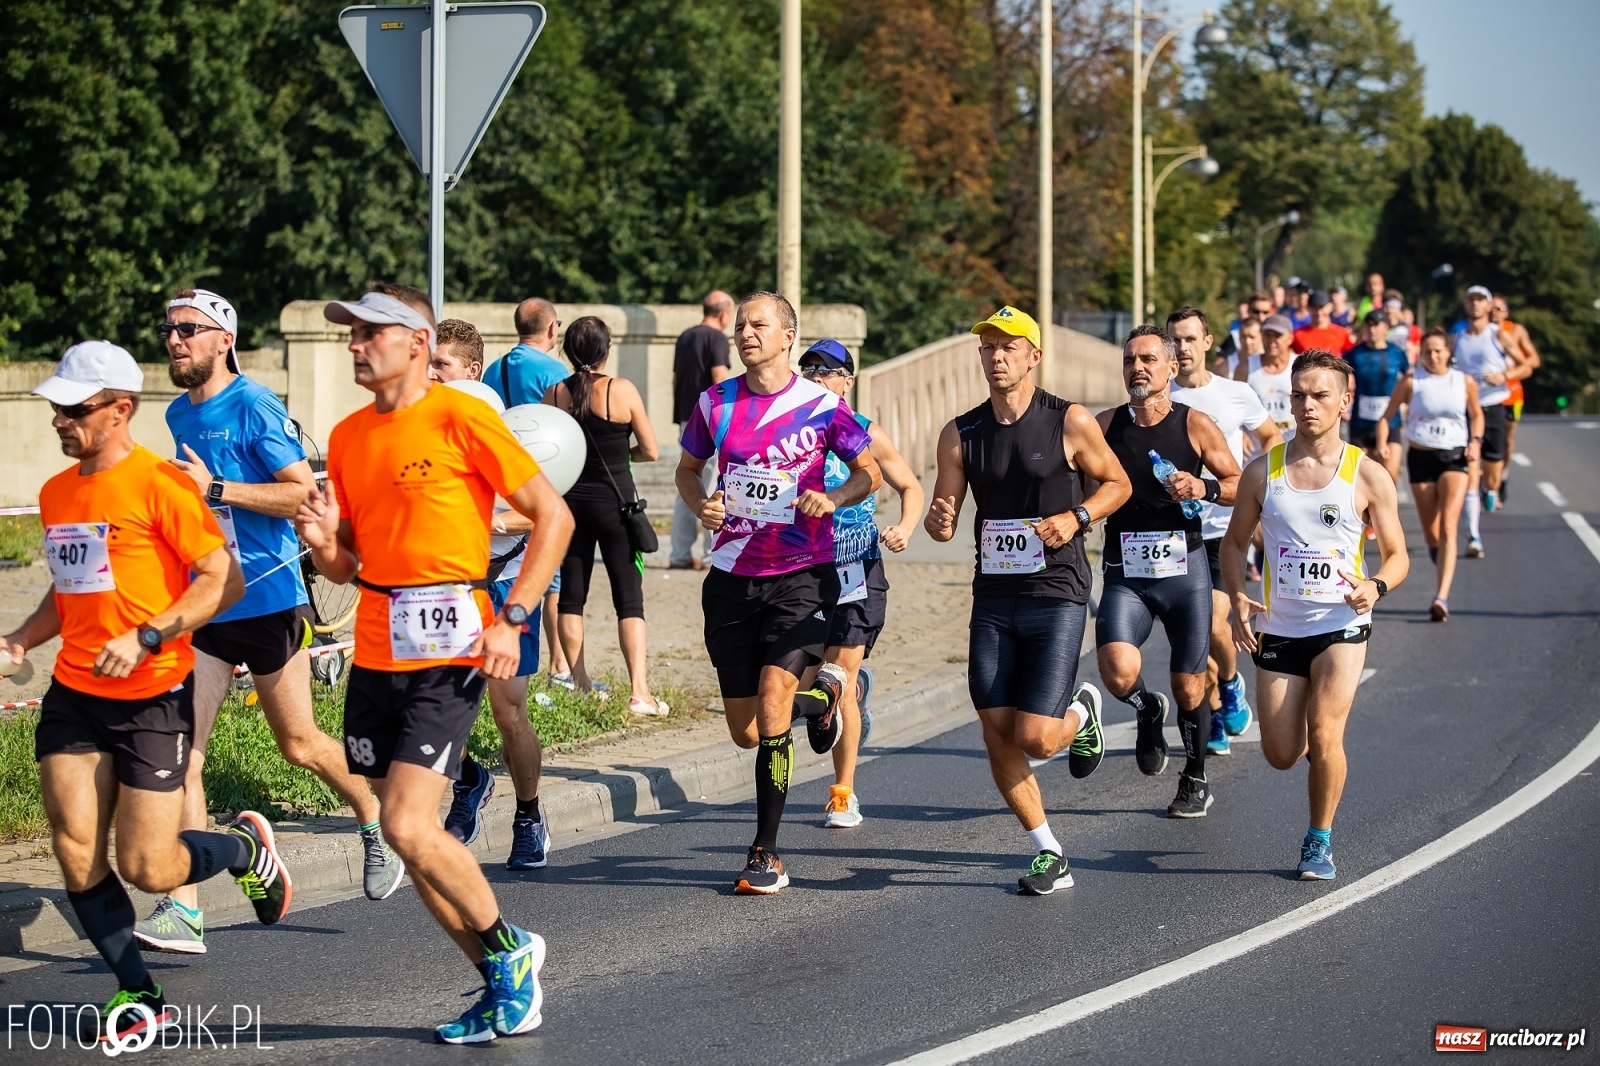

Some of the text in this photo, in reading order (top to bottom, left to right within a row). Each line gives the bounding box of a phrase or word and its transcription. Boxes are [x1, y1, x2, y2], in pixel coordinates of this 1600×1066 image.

[745, 481, 779, 501] 203
[995, 534, 1027, 552] 290
[1141, 544, 1171, 560] 365
[59, 543, 89, 566] 407
[1299, 562, 1331, 580] 140
[418, 606, 459, 630] 194
[761, 736, 787, 746] cep
[346, 735, 376, 767] 88
